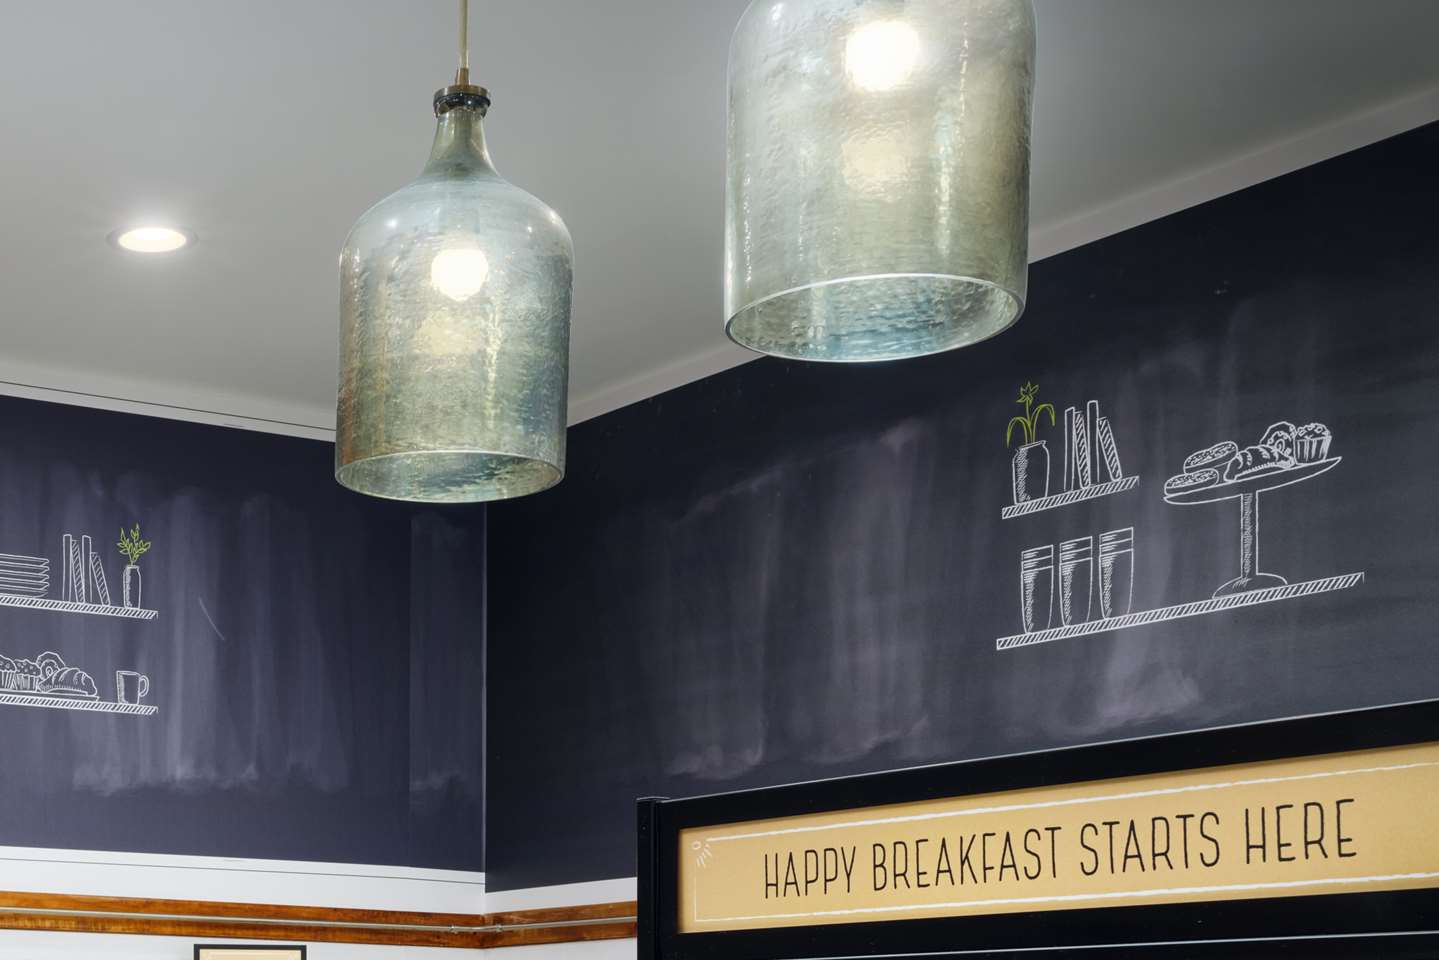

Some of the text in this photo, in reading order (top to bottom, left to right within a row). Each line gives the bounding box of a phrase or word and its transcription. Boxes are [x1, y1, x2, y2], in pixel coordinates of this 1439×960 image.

[765, 798, 1357, 899] HAPPY BREAKFAST STARTS HERE
